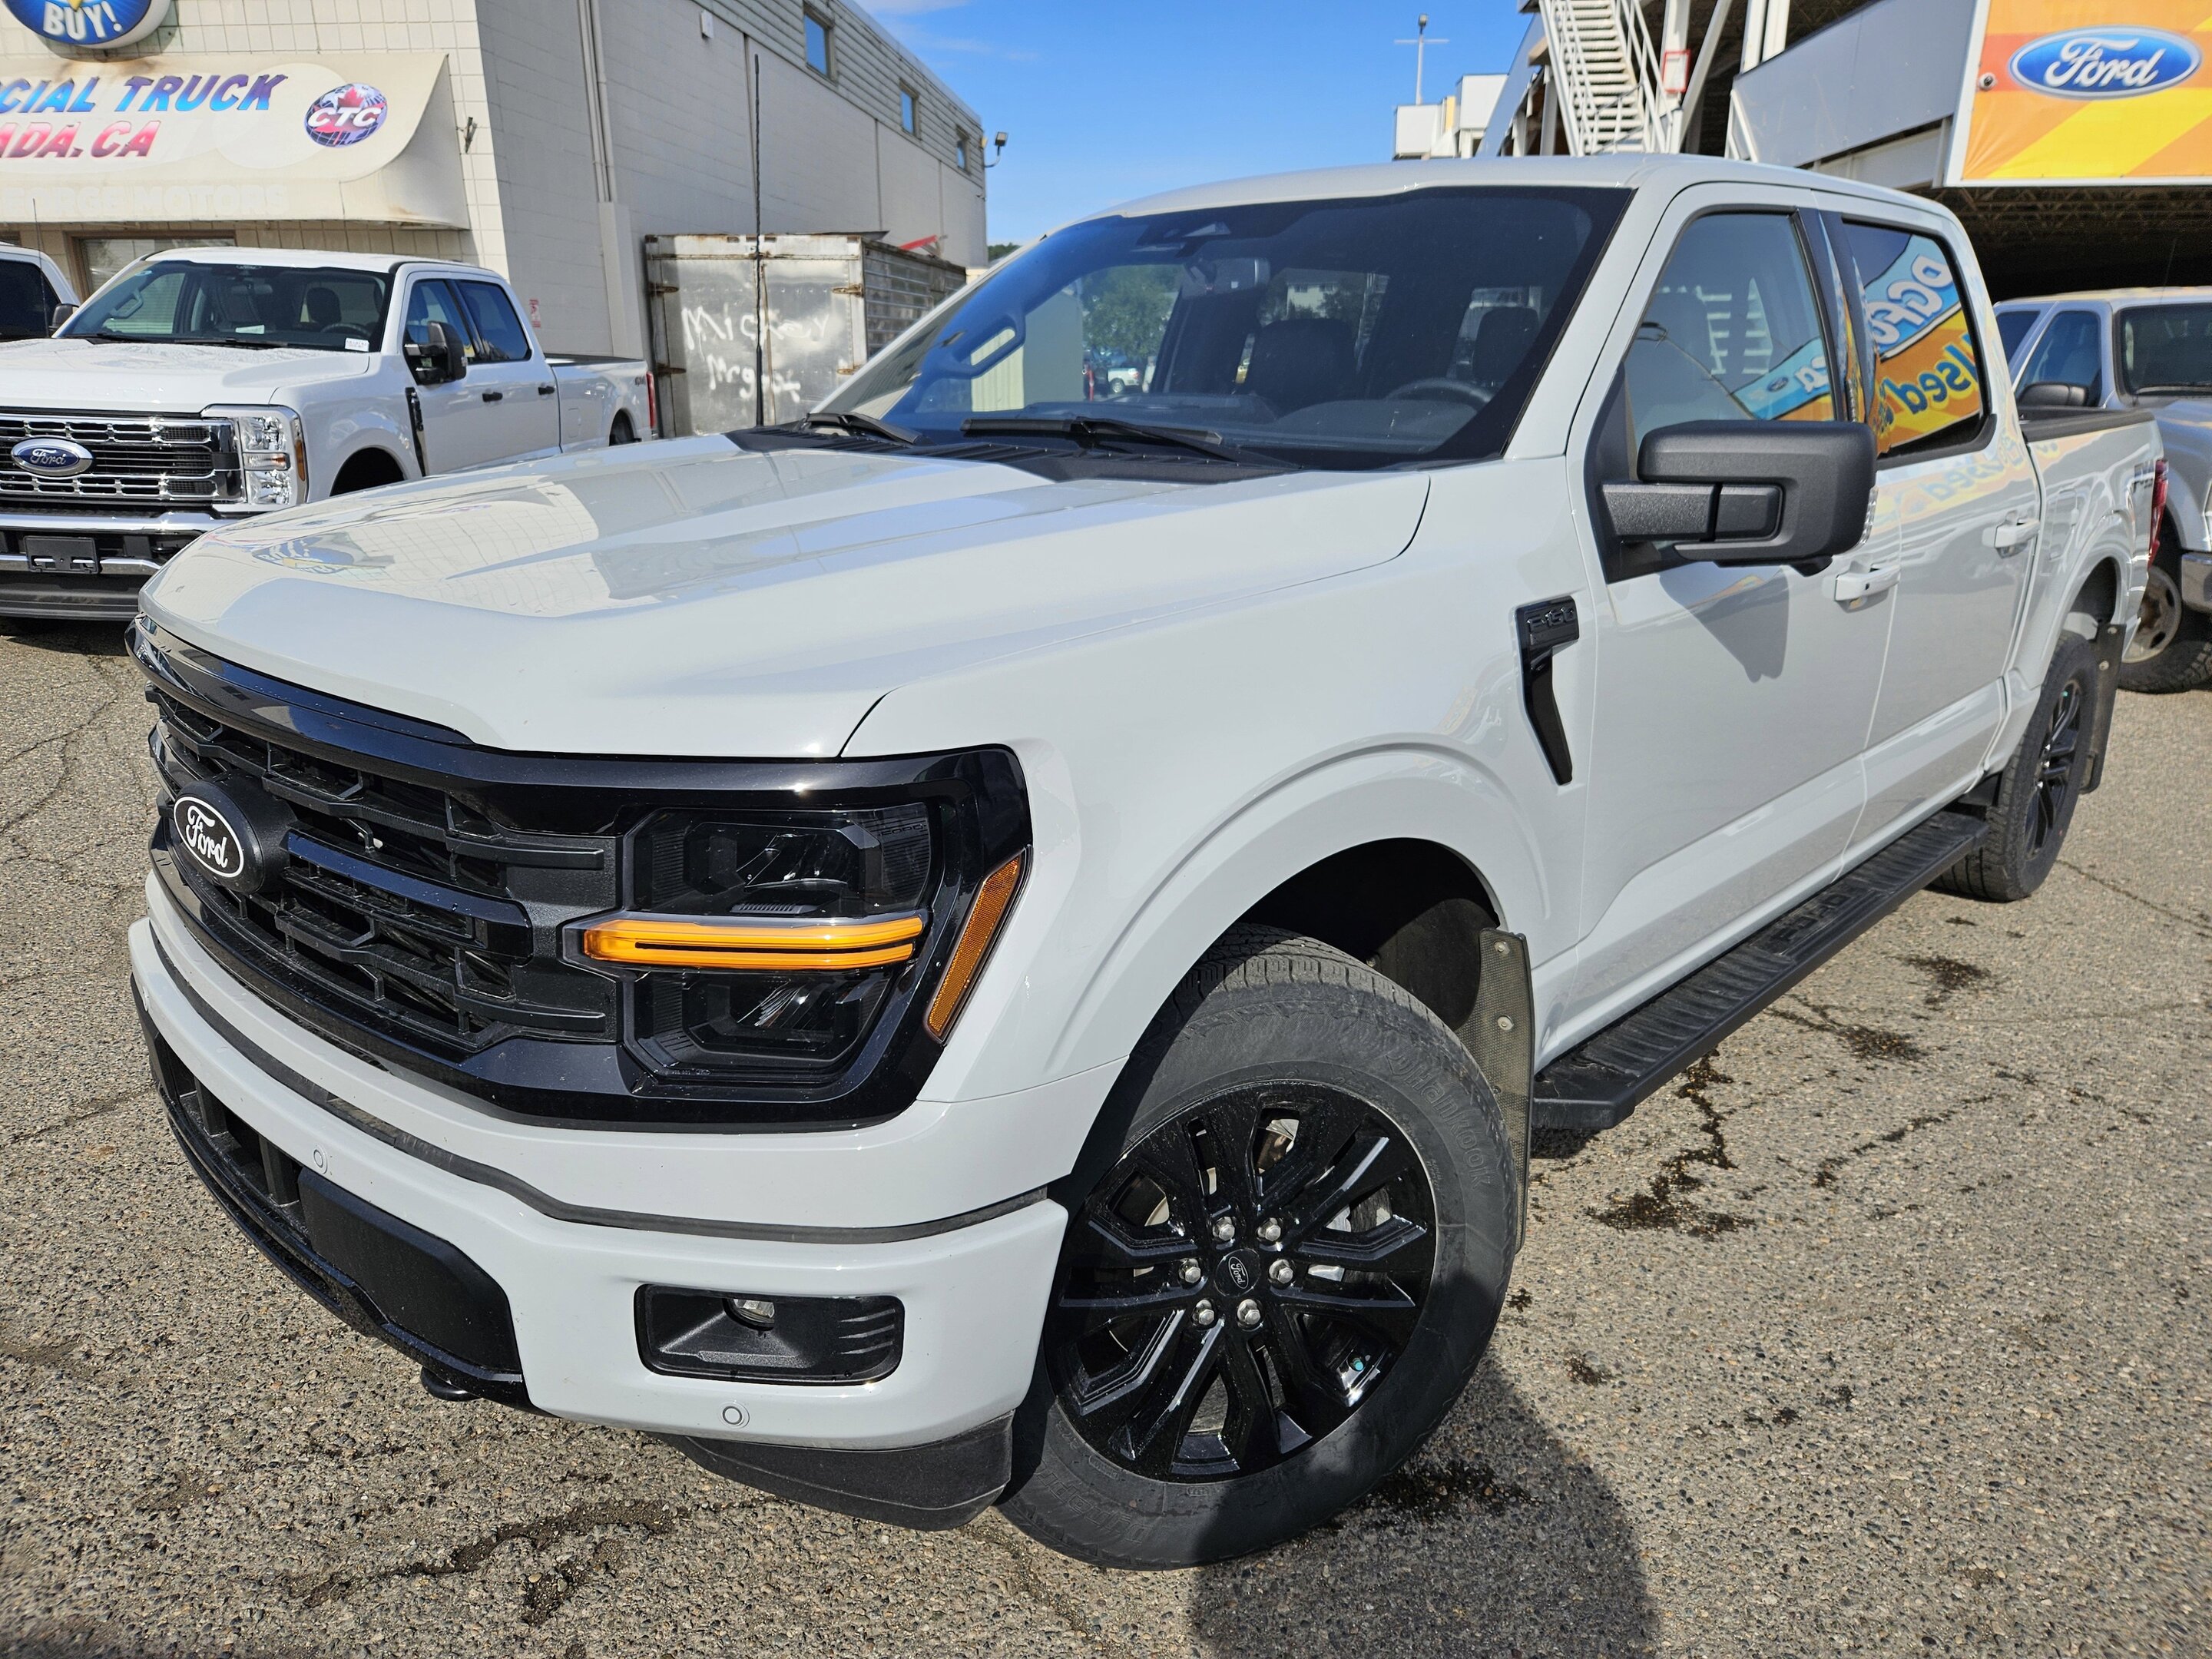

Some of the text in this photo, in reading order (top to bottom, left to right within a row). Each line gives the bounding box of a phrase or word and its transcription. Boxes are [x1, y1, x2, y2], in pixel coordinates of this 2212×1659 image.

[43, 2, 123, 40] BUY!
[2045, 38, 2167, 88] Ford
[114, 74, 288, 112] TRUCK
[308, 108, 382, 127] CTC
[30, 449, 67, 465] Ford
[1526, 607, 1575, 633] F-150
[186, 805, 229, 868] Ford
[1404, 1065, 1492, 1190] Hankook
[1230, 1263, 1246, 1285] Ford
